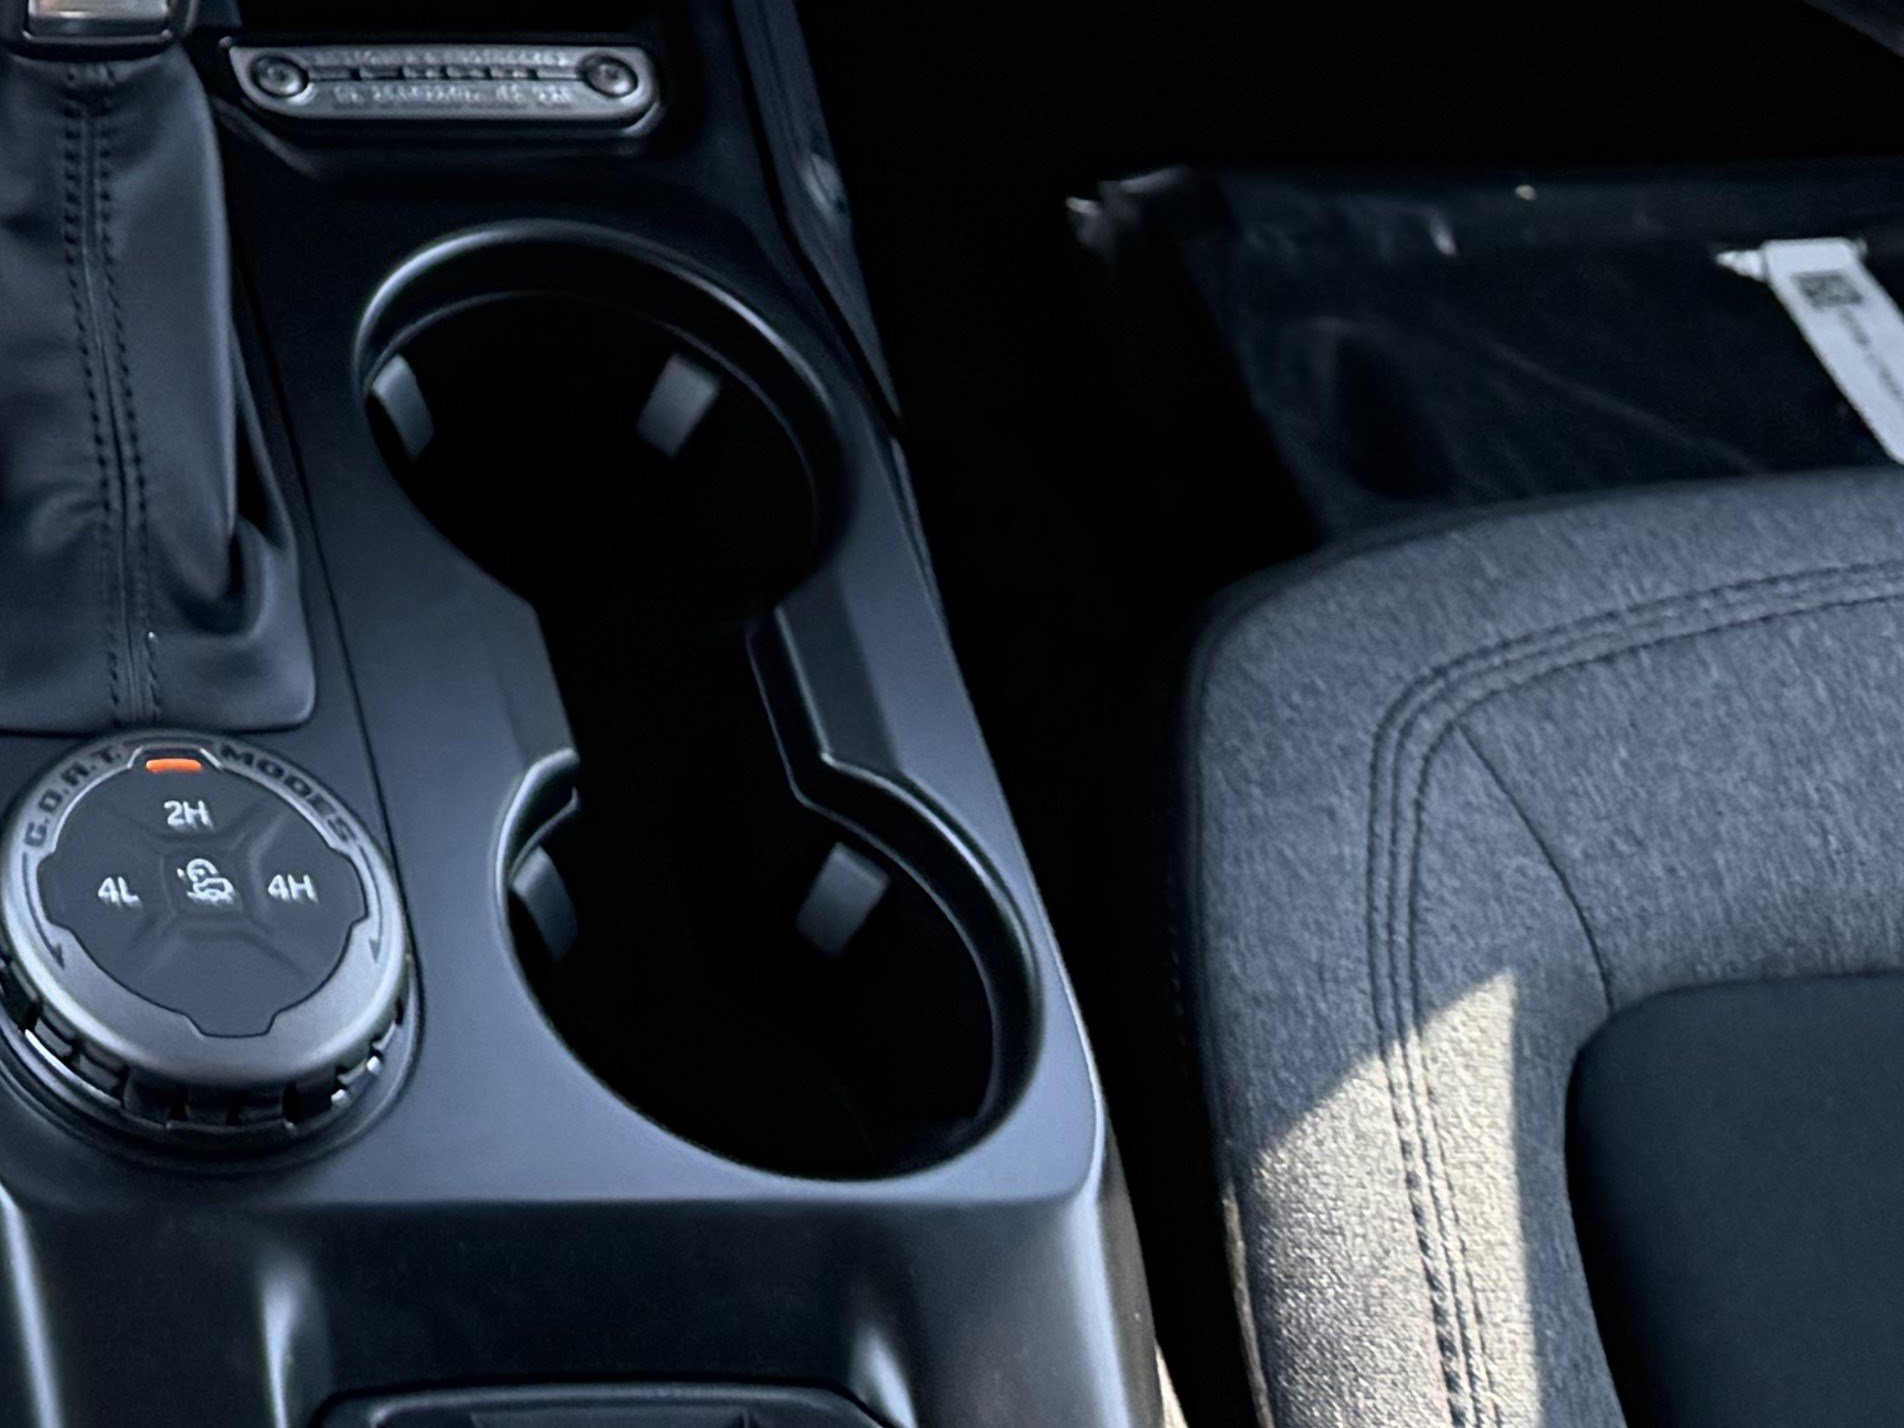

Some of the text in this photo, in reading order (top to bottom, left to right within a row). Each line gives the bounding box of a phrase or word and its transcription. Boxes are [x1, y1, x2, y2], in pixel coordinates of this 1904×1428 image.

[219, 745, 357, 844] MODES
[163, 800, 214, 832] 2H
[97, 877, 143, 909] 4L
[266, 874, 319, 907] 4H
